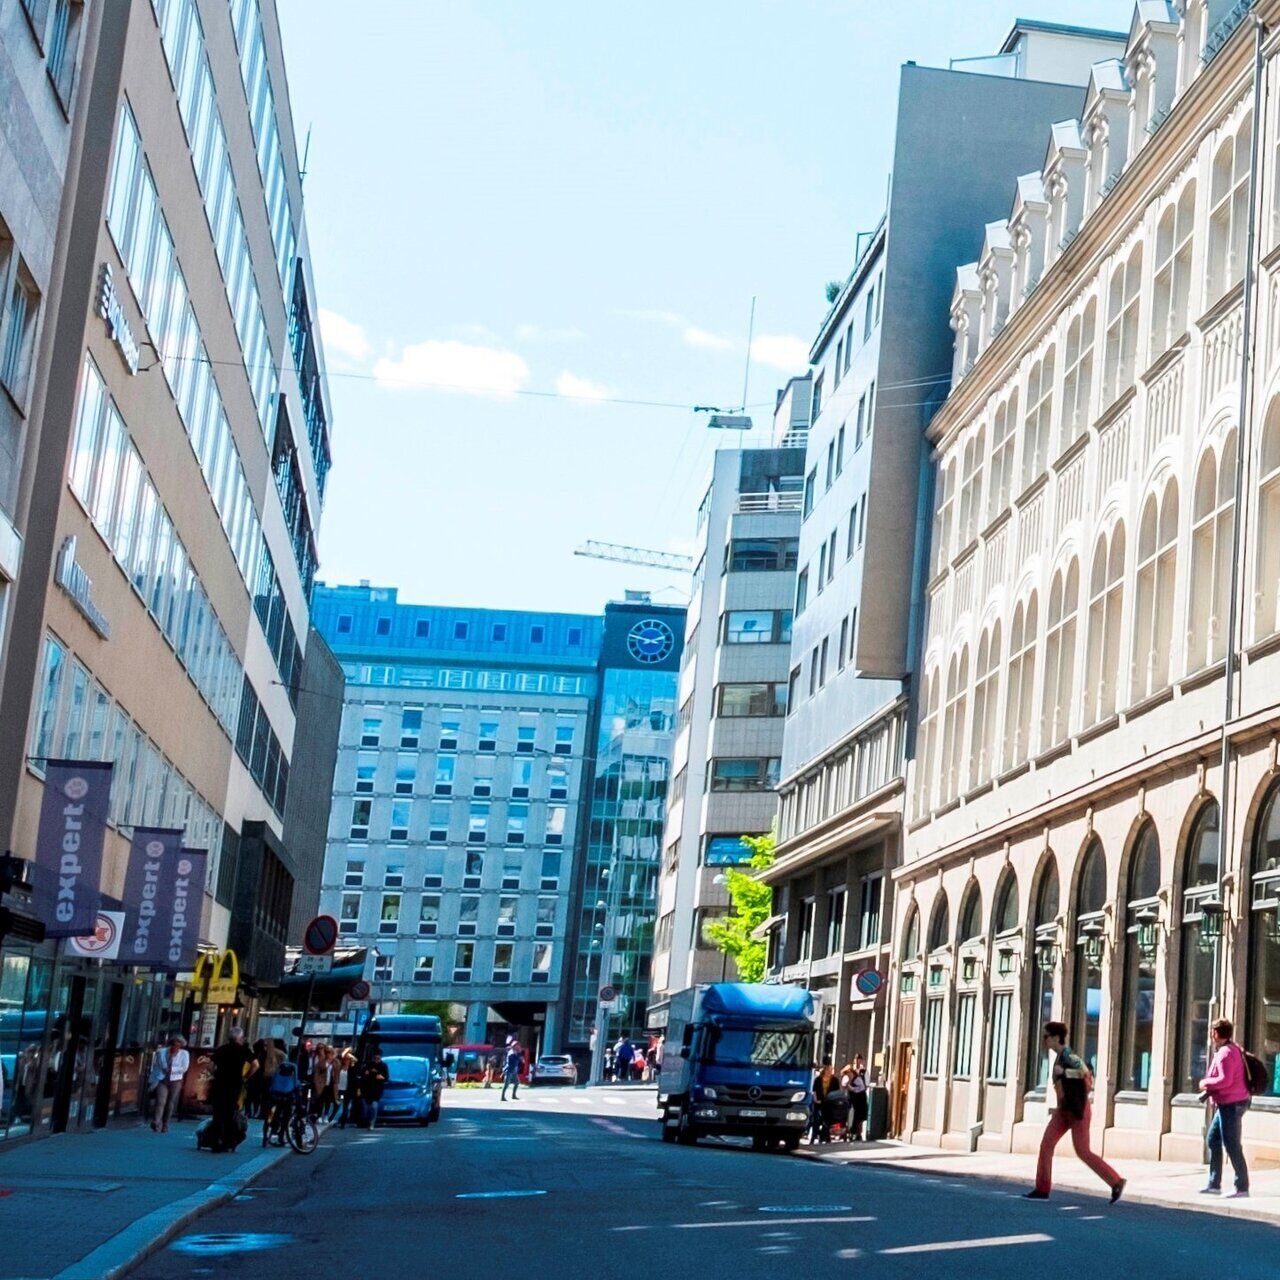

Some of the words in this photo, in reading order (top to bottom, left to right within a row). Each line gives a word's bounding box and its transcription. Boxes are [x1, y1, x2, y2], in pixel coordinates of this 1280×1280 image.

[56, 803, 85, 923] expert
[134, 861, 161, 955] expert
[168, 877, 190, 962] expert
